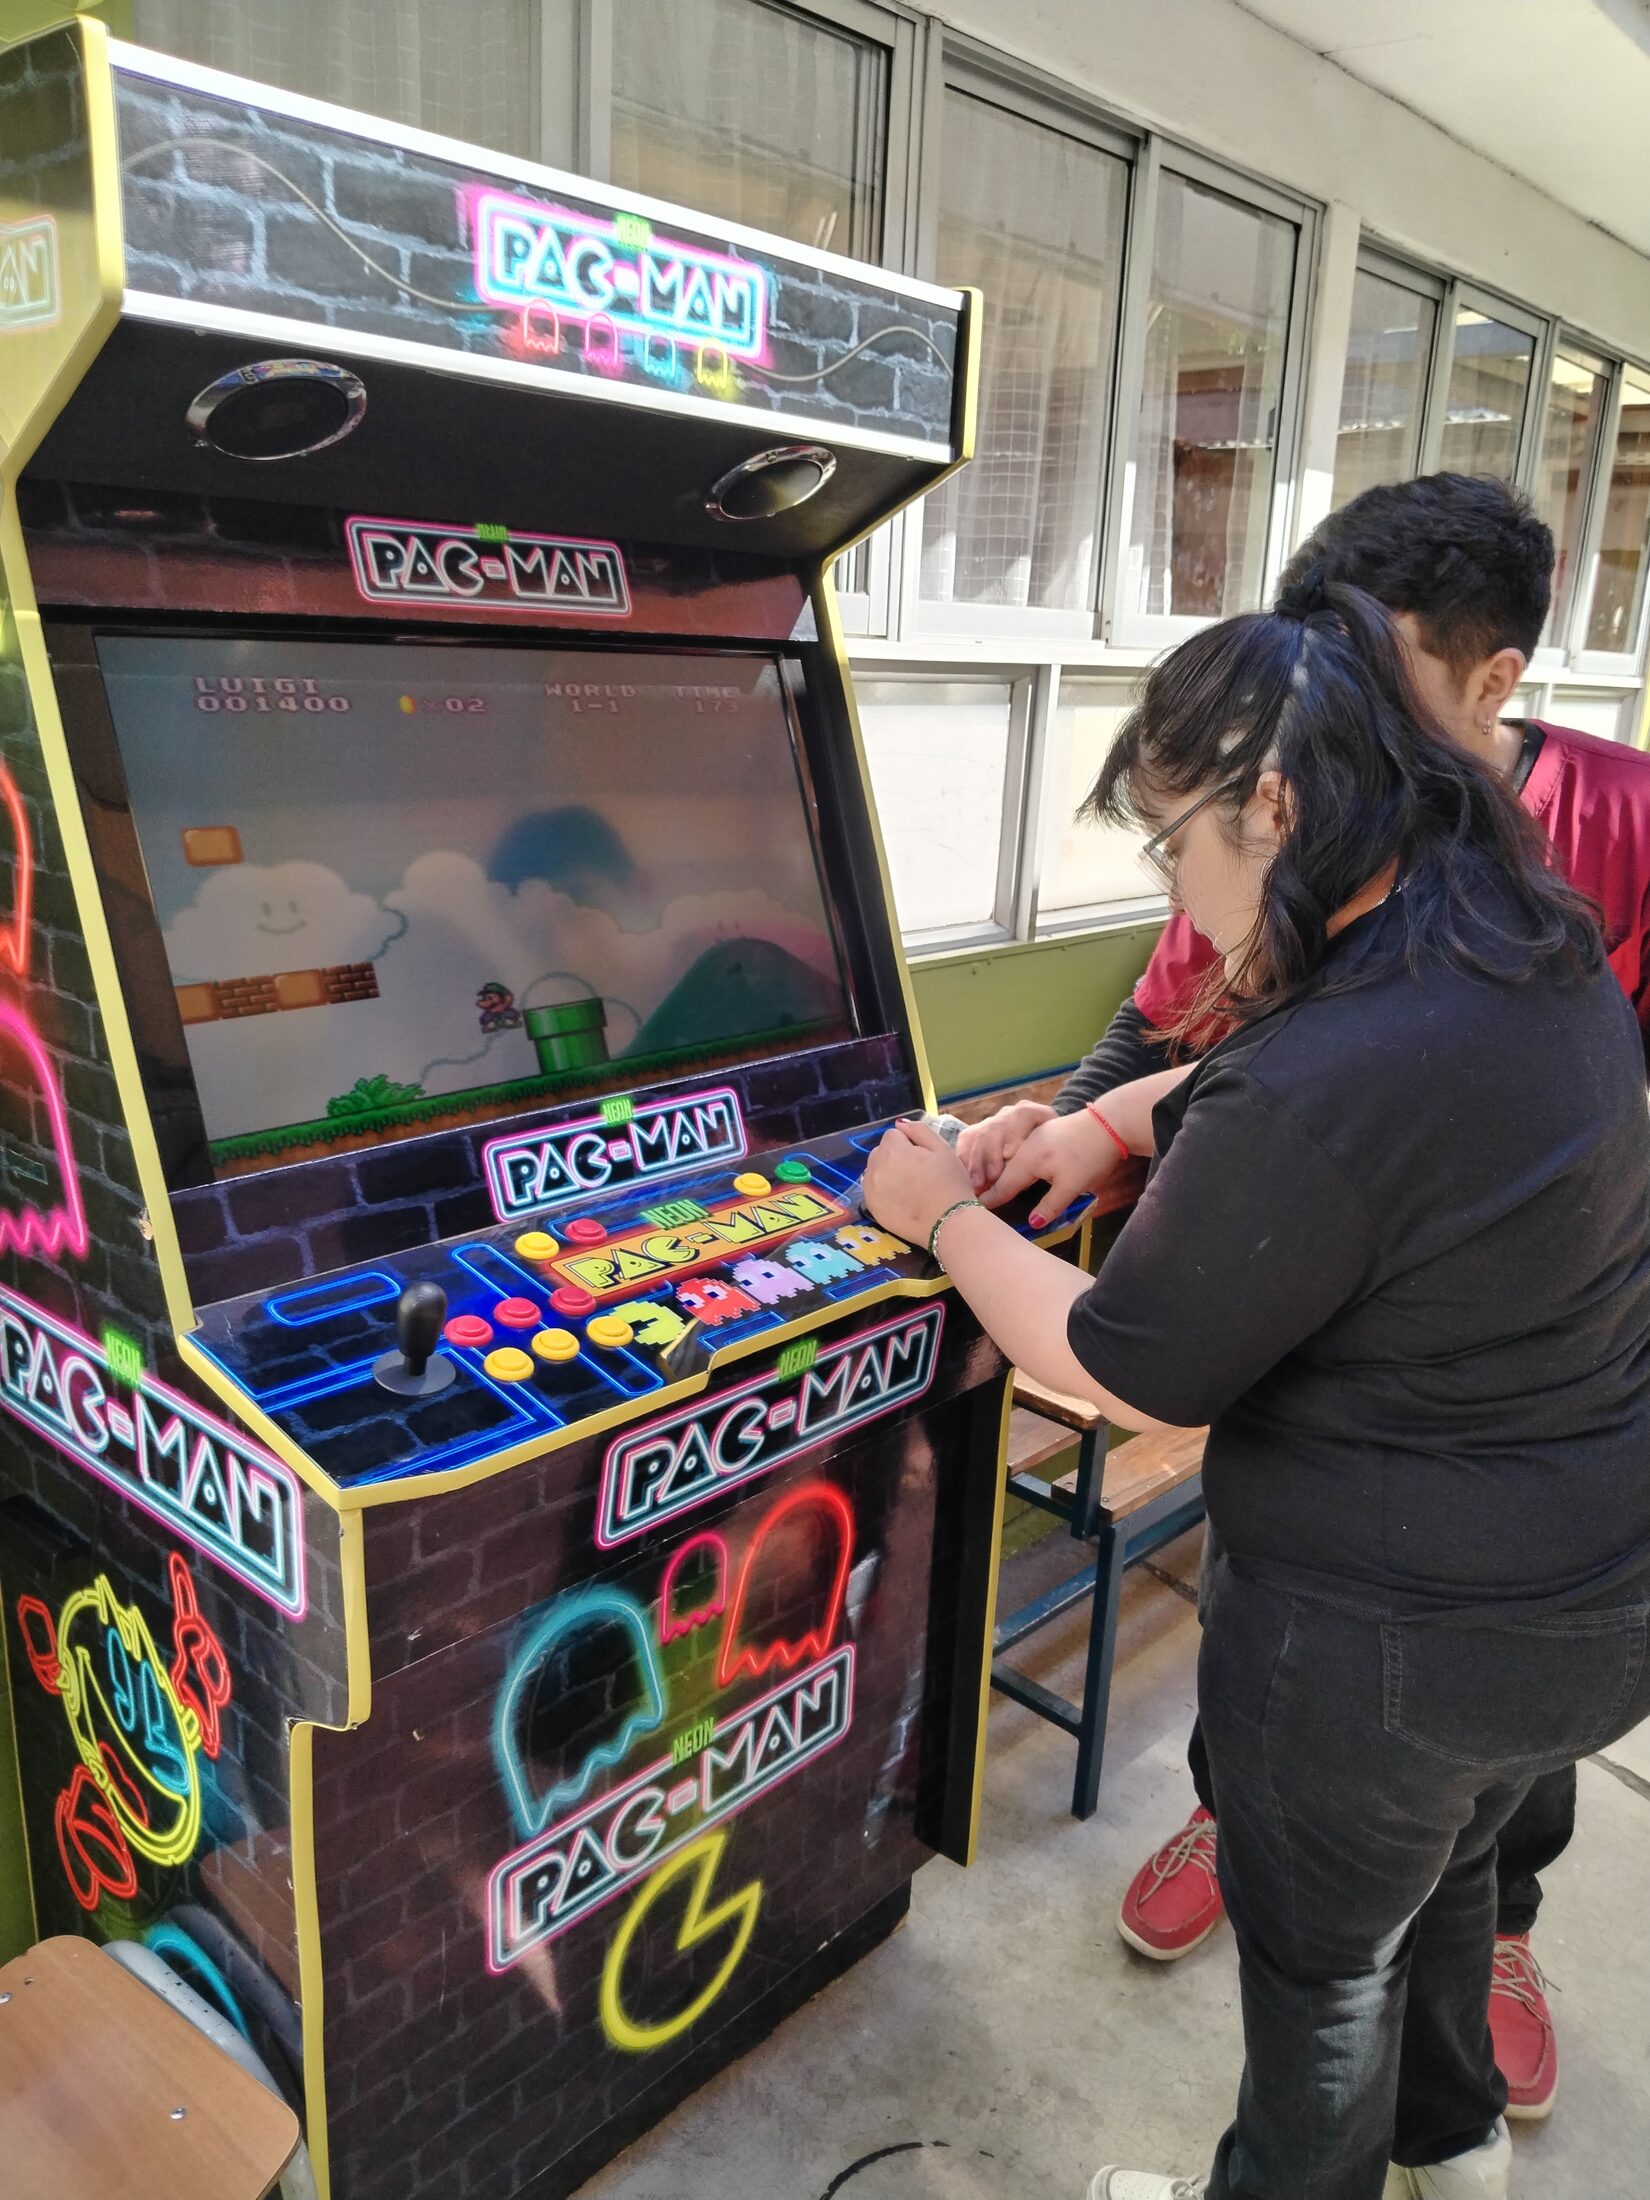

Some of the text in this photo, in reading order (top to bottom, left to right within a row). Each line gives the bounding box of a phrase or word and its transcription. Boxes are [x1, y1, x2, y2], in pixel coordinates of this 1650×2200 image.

[492, 212, 752, 346] PAC-MAN
[361, 532, 618, 604] PAC-MAN
[195, 677, 319, 694] LUIGI
[197, 695, 350, 713] 001400
[544, 683, 637, 698] WORLD
[570, 700, 619, 713] 1-1
[602, 1099, 634, 1125] NEON
[498, 1101, 736, 1207] PAC-MAN
[640, 1198, 713, 1230] NEON
[563, 1192, 836, 1289] PAC-MAN
[778, 1339, 819, 1380] NEON
[0, 1308, 285, 1585] PAC-MAN
[618, 1323, 928, 1521] PAC-MAN
[672, 1716, 715, 1766] NEON
[508, 1668, 838, 1942] PAC-MAN
